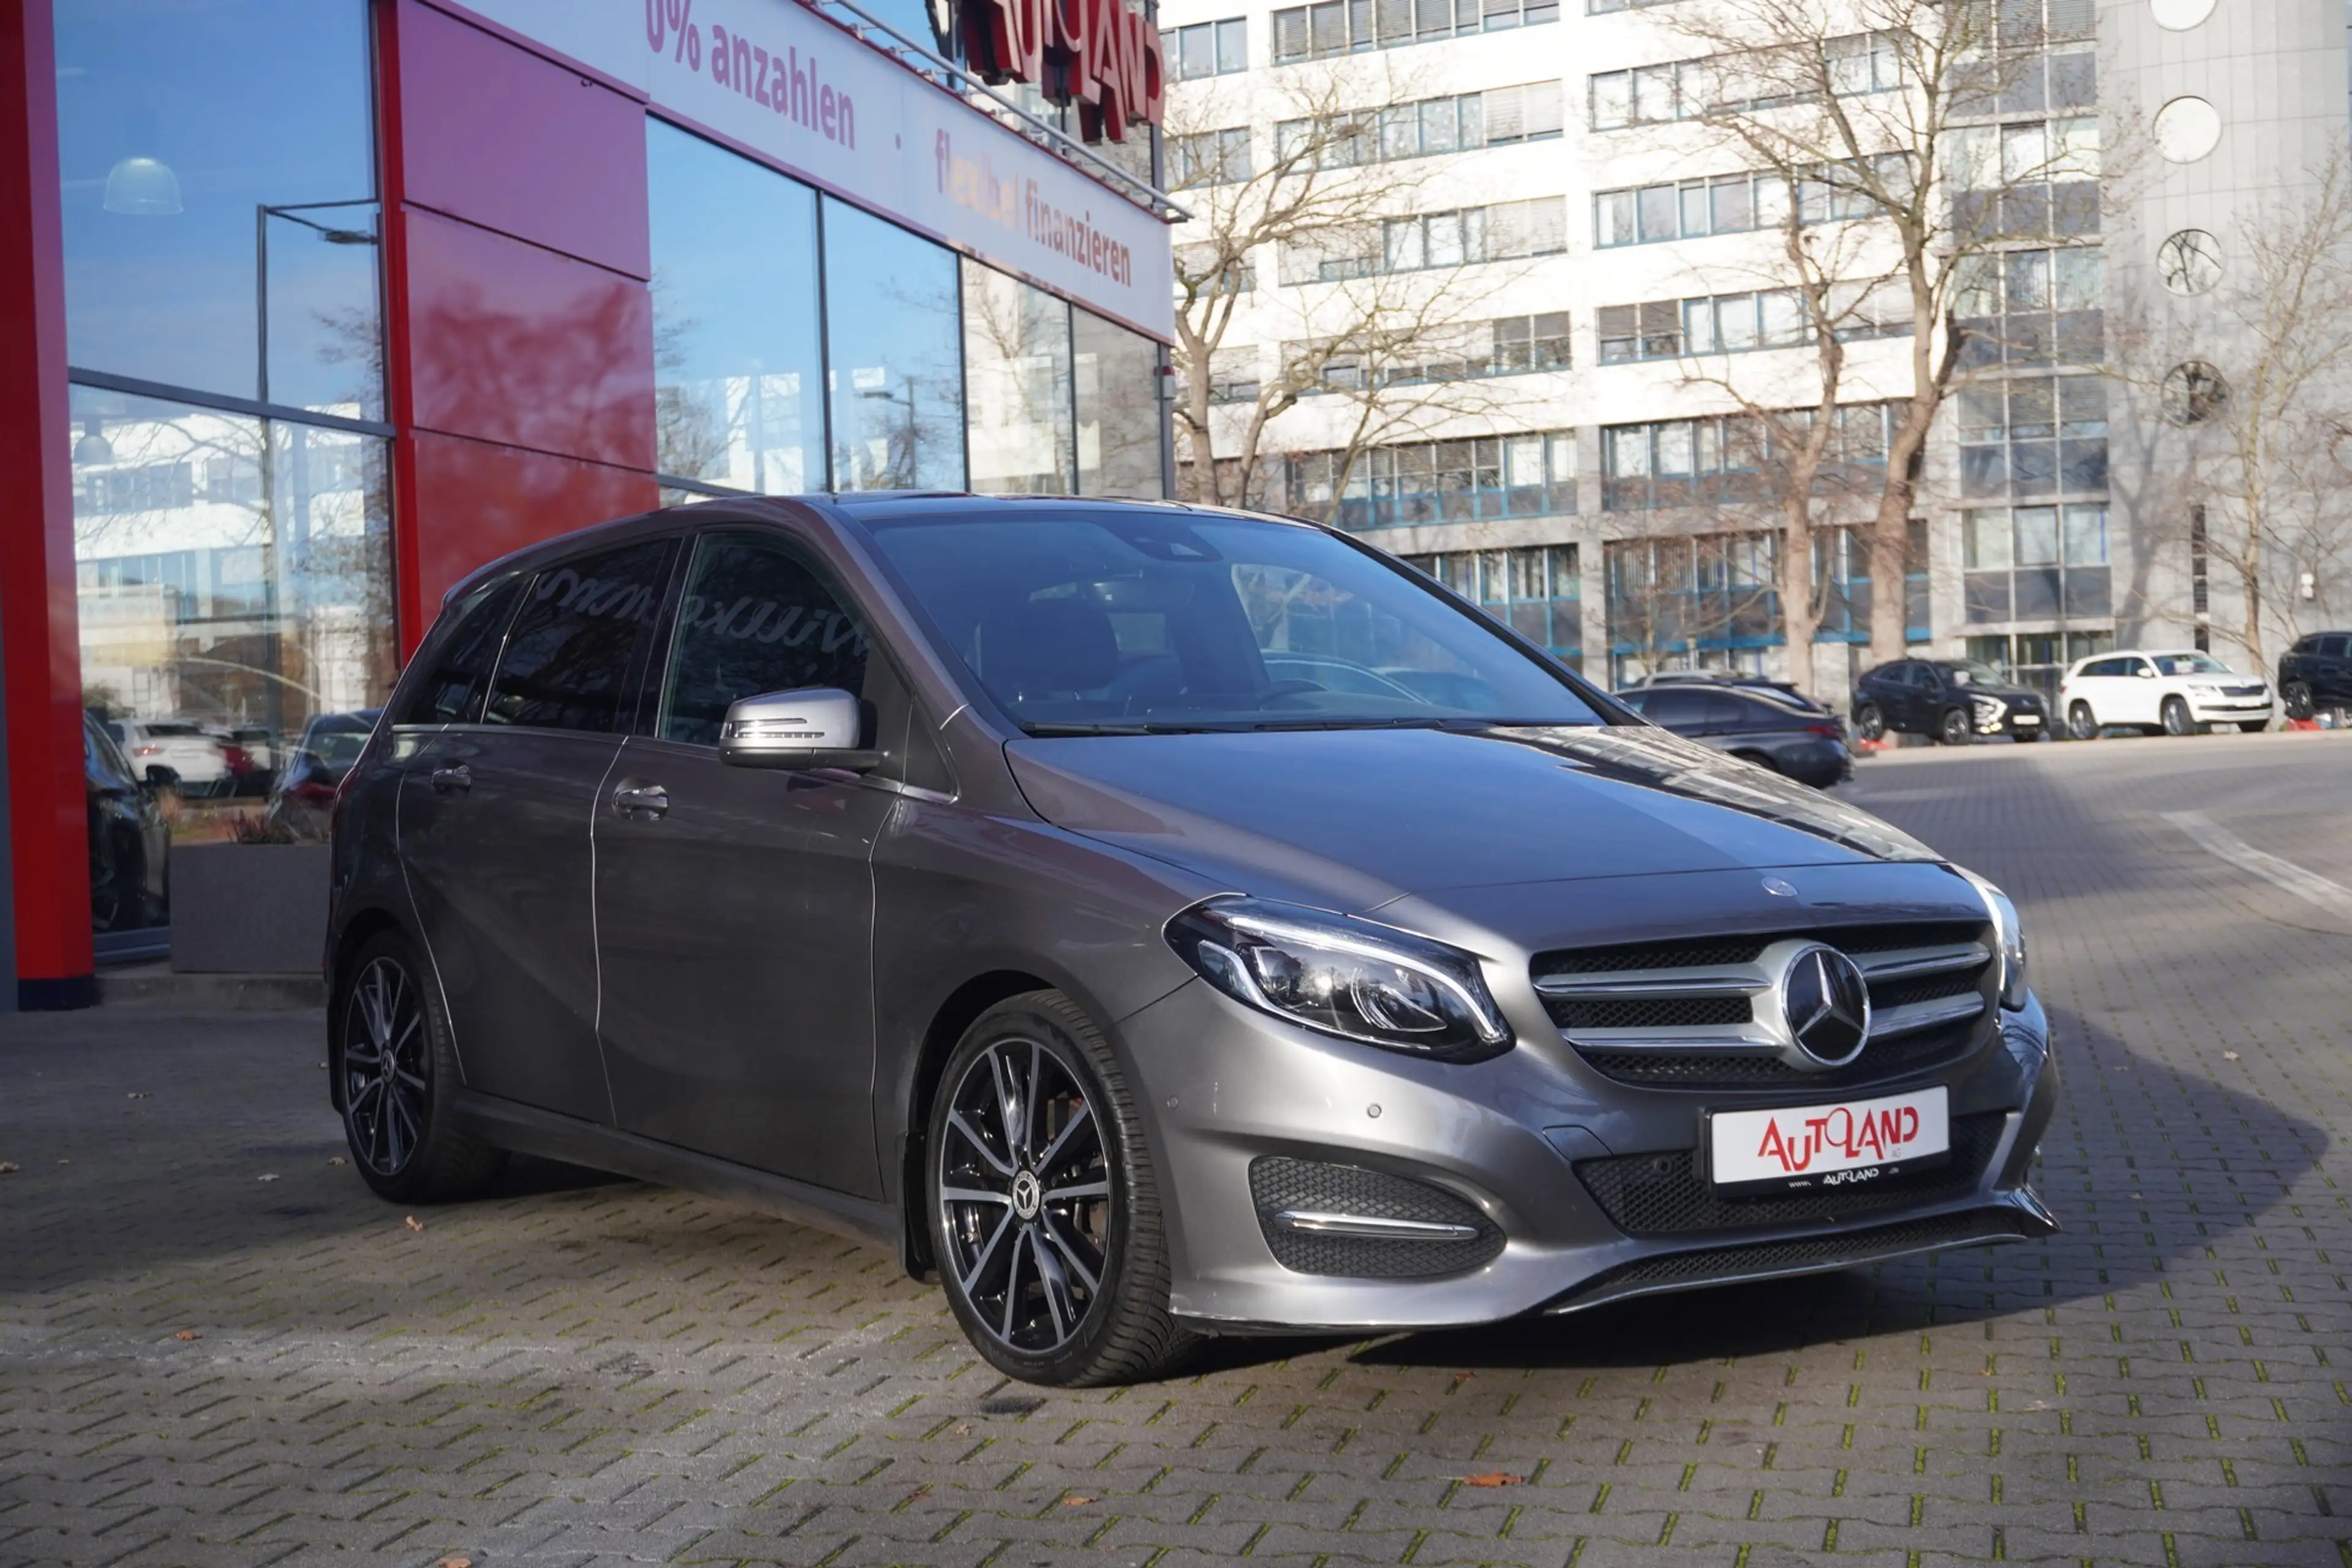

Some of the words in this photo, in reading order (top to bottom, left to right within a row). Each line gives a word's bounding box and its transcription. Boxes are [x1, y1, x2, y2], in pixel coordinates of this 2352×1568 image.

[711, 24, 855, 151] anzahlen
[1025, 178, 1131, 288] finanzieren
[1757, 1106, 1920, 1172] AUTOLAND
[1823, 1167, 1879, 1185] AUTOLAND
